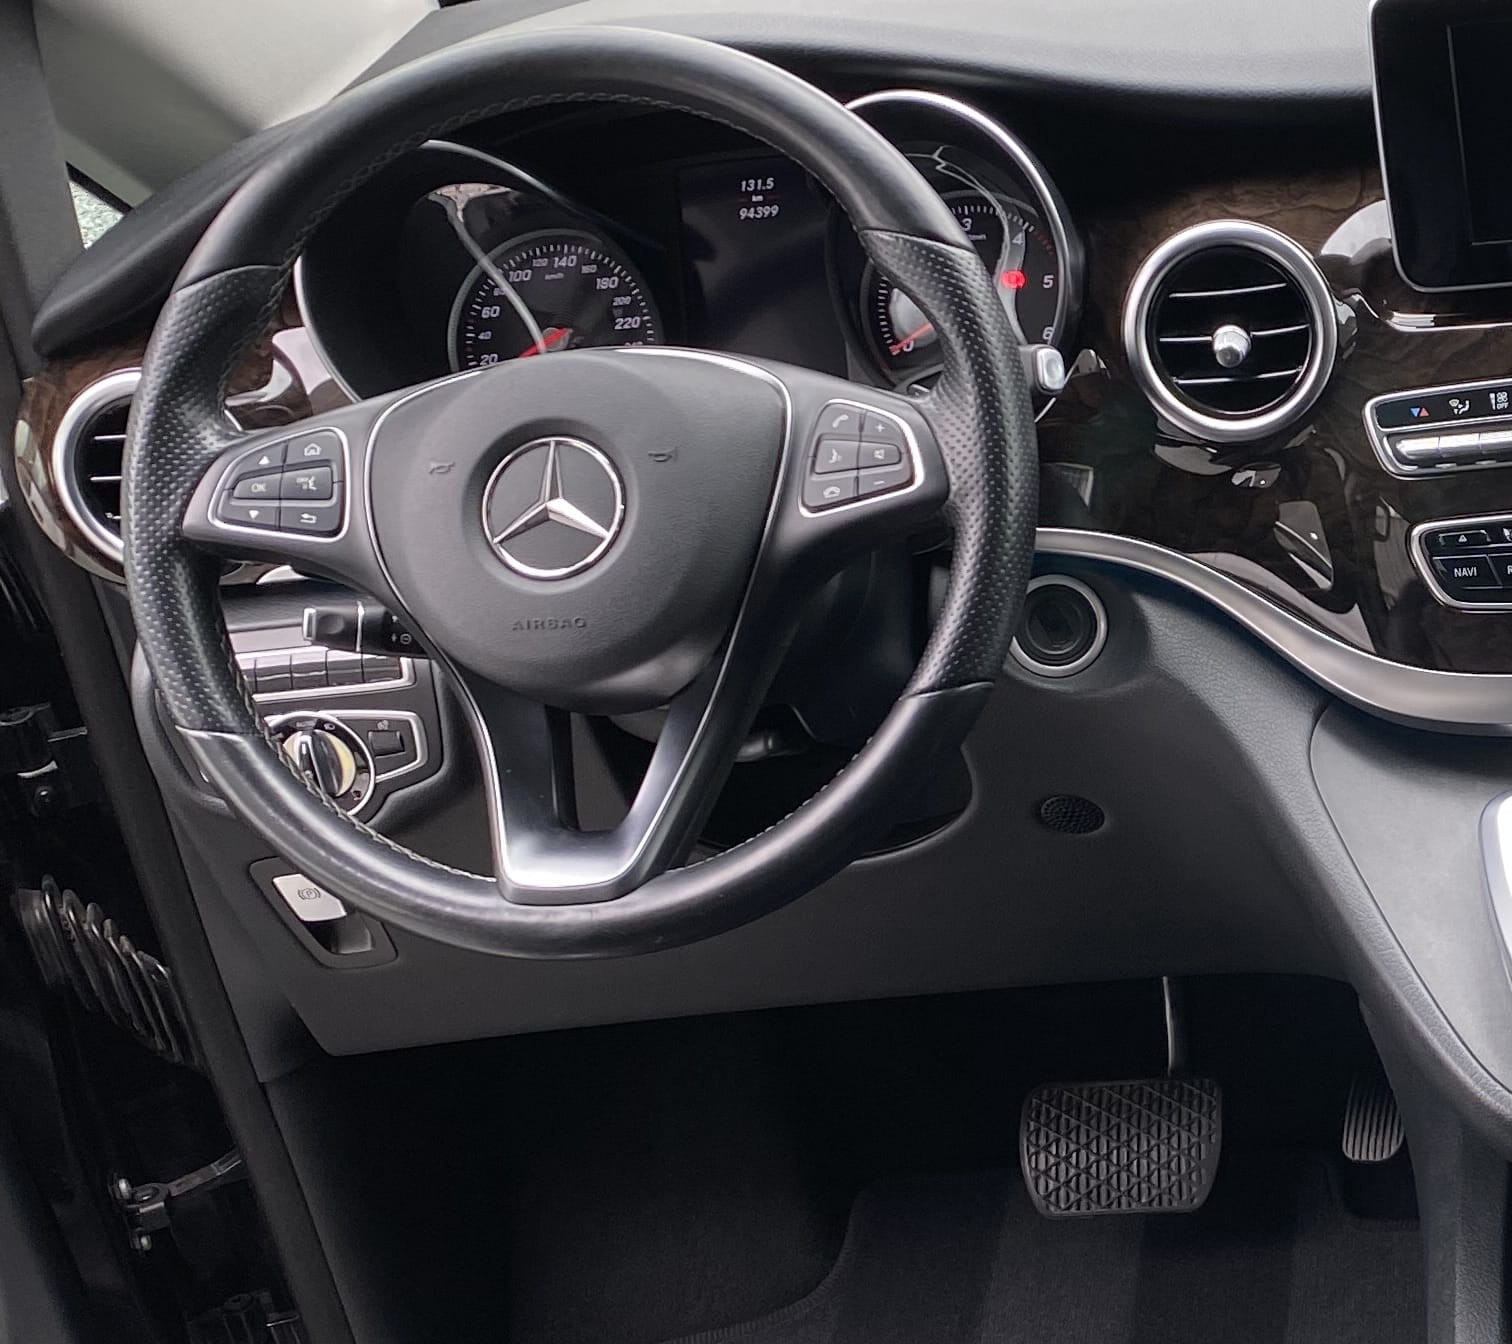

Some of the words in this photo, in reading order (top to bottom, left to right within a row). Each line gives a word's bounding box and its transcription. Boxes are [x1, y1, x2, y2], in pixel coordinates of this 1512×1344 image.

[741, 177, 775, 192] 131.5
[740, 205, 779, 220] 94399
[961, 218, 973, 232] 3
[1012, 231, 1025, 245] 4
[532, 258, 549, 267] 120
[553, 255, 577, 268] 140
[509, 269, 532, 282] 100
[581, 264, 597, 274] 160
[1042, 275, 1055, 289] 5
[612, 296, 632, 306] 200
[481, 306, 500, 318] 60
[614, 316, 641, 330] 220
[478, 330, 492, 340] 40
[1042, 326, 1055, 340] 6
[480, 353, 498, 366] 20
[1496, 402, 1509, 410] OFF
[251, 483, 267, 493] OK
[1453, 566, 1477, 578] NAVI
